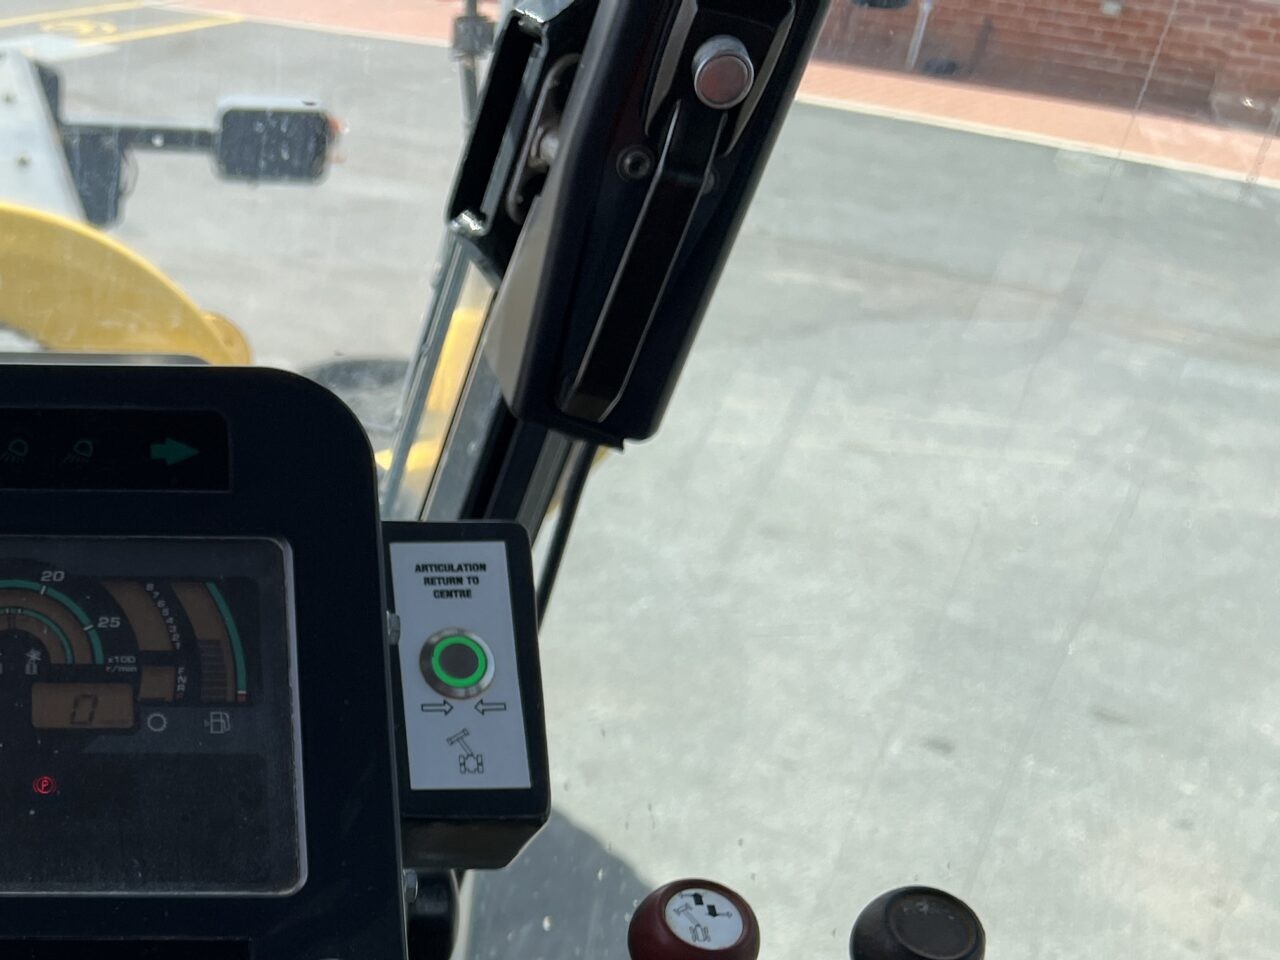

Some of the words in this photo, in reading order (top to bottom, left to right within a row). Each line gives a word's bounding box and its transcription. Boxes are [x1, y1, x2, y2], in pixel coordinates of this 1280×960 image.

[414, 563, 487, 573] ARTICULATION
[40, 570, 65, 582] 20
[423, 576, 464, 586] RETURN
[467, 576, 480, 585] TO
[432, 588, 472, 599] CENTRE
[98, 616, 121, 629] 25
